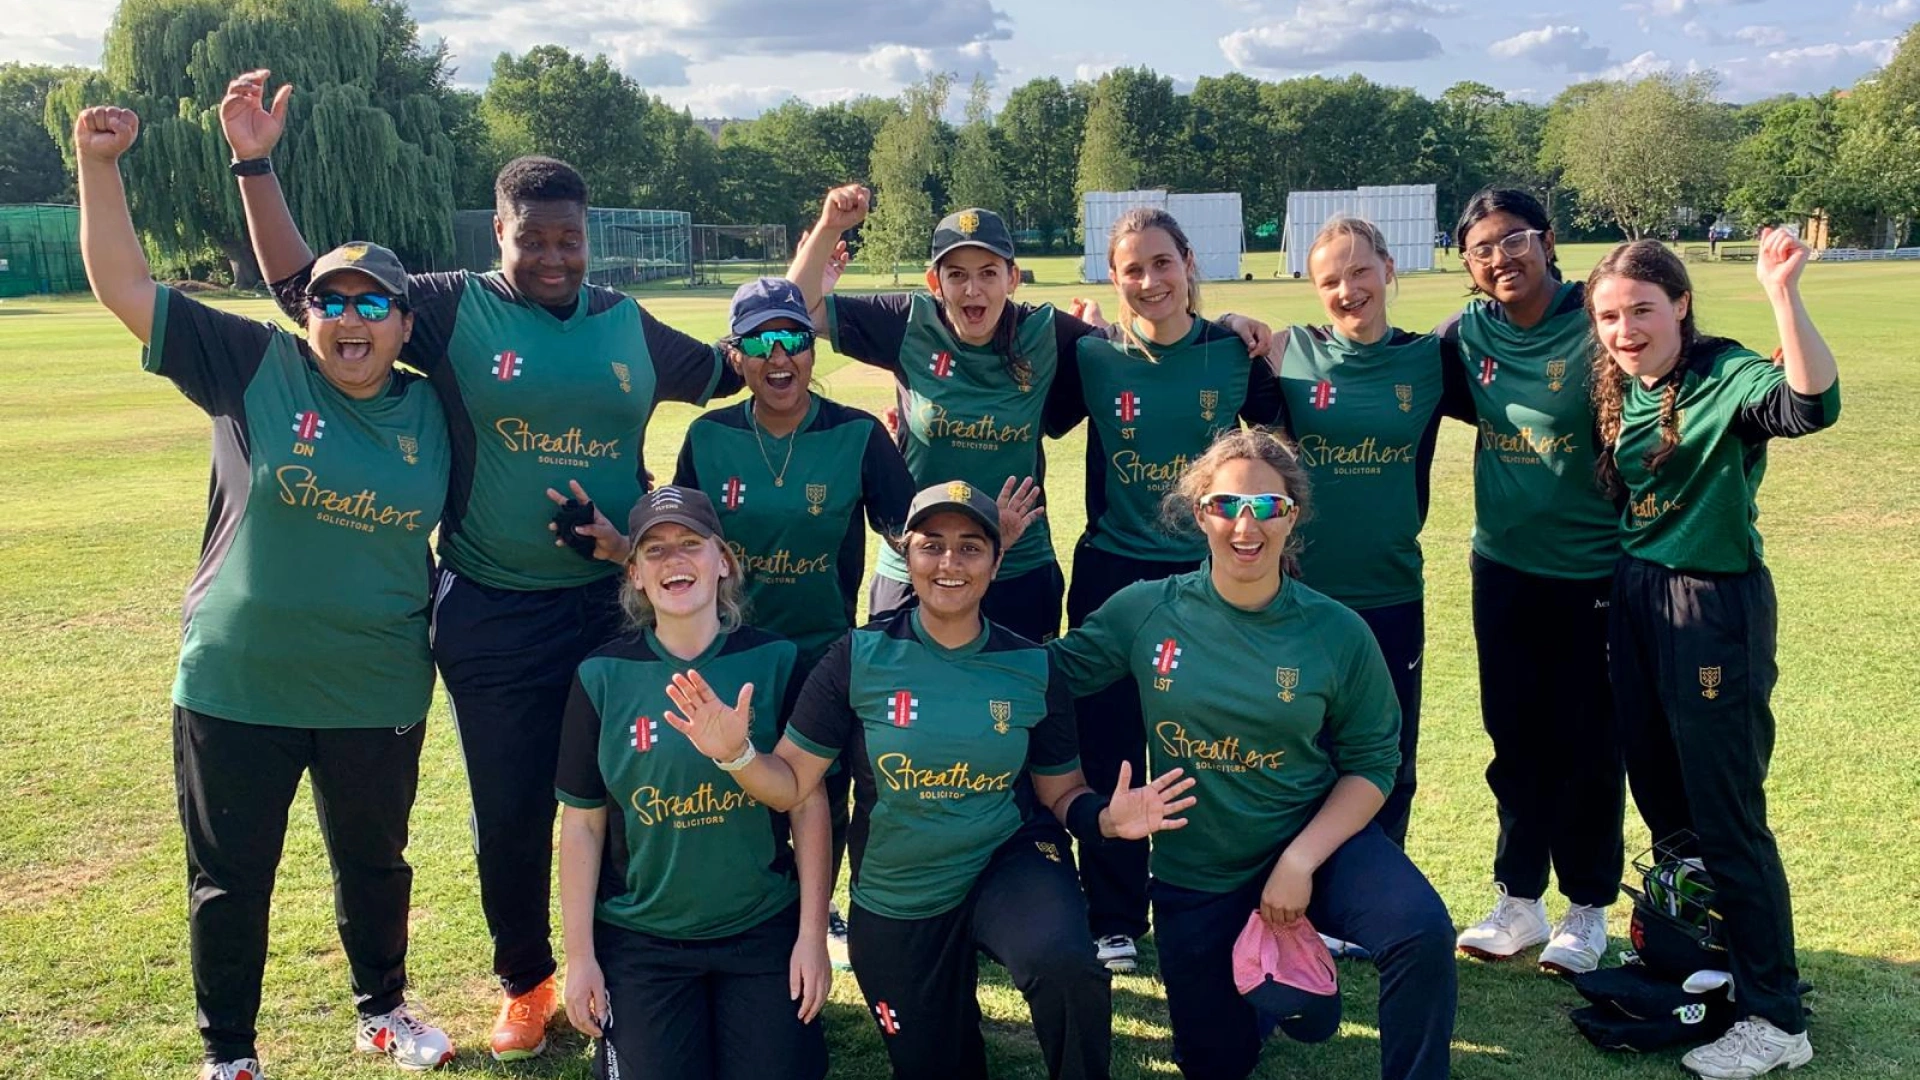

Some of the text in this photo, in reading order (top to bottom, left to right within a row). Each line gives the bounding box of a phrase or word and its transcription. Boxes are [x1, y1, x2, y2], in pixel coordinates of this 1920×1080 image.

[920, 403, 1031, 442] Streathers
[496, 417, 620, 459] Streathers
[1121, 427, 1136, 440] ST
[292, 442, 315, 457] DN
[951, 440, 998, 451] SOLICITORS
[1299, 434, 1414, 467] Streathers
[538, 455, 589, 468] SOLICITORS
[1334, 467, 1381, 475] SOLICITORS
[276, 465, 422, 531] Streathers
[316, 512, 375, 533] SOLICITORS
[1153, 677, 1174, 692] LST
[1156, 721, 1285, 769] Streathers
[877, 753, 1011, 791] Streathers
[1195, 761, 1247, 773] SOLICITORS
